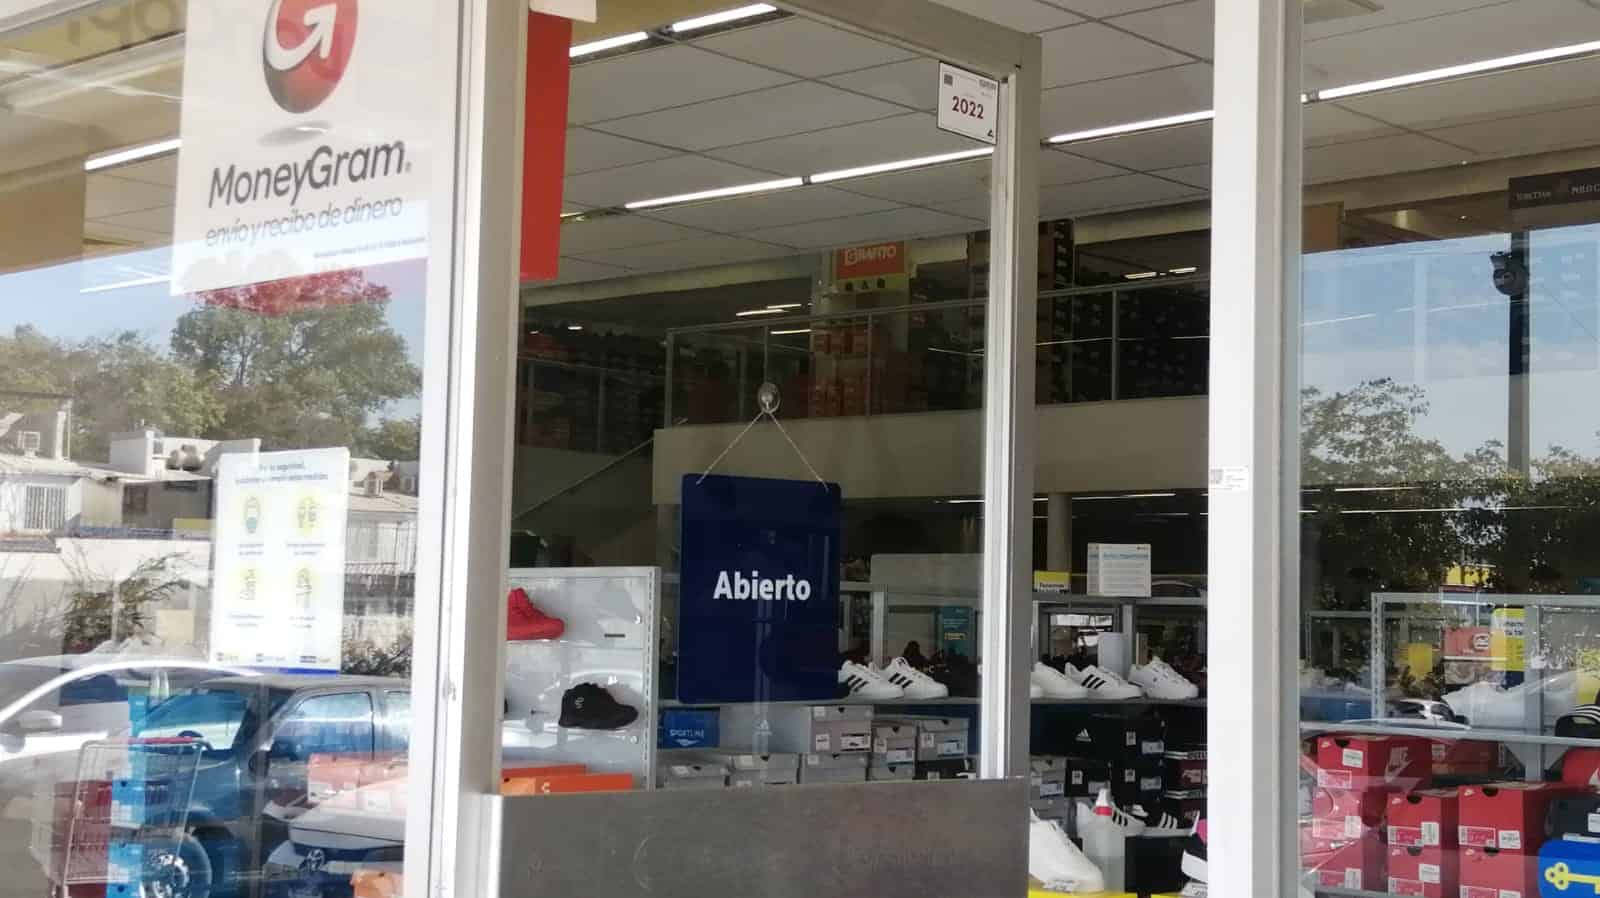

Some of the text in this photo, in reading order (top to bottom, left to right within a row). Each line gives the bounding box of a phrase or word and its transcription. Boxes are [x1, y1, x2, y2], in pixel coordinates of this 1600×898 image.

[951, 95, 984, 120] 2022
[208, 140, 405, 208] MoneyGram
[262, 209, 316, 239] recibo
[318, 203, 341, 229] de
[343, 196, 403, 226] dinero
[712, 570, 812, 601] Abierto
